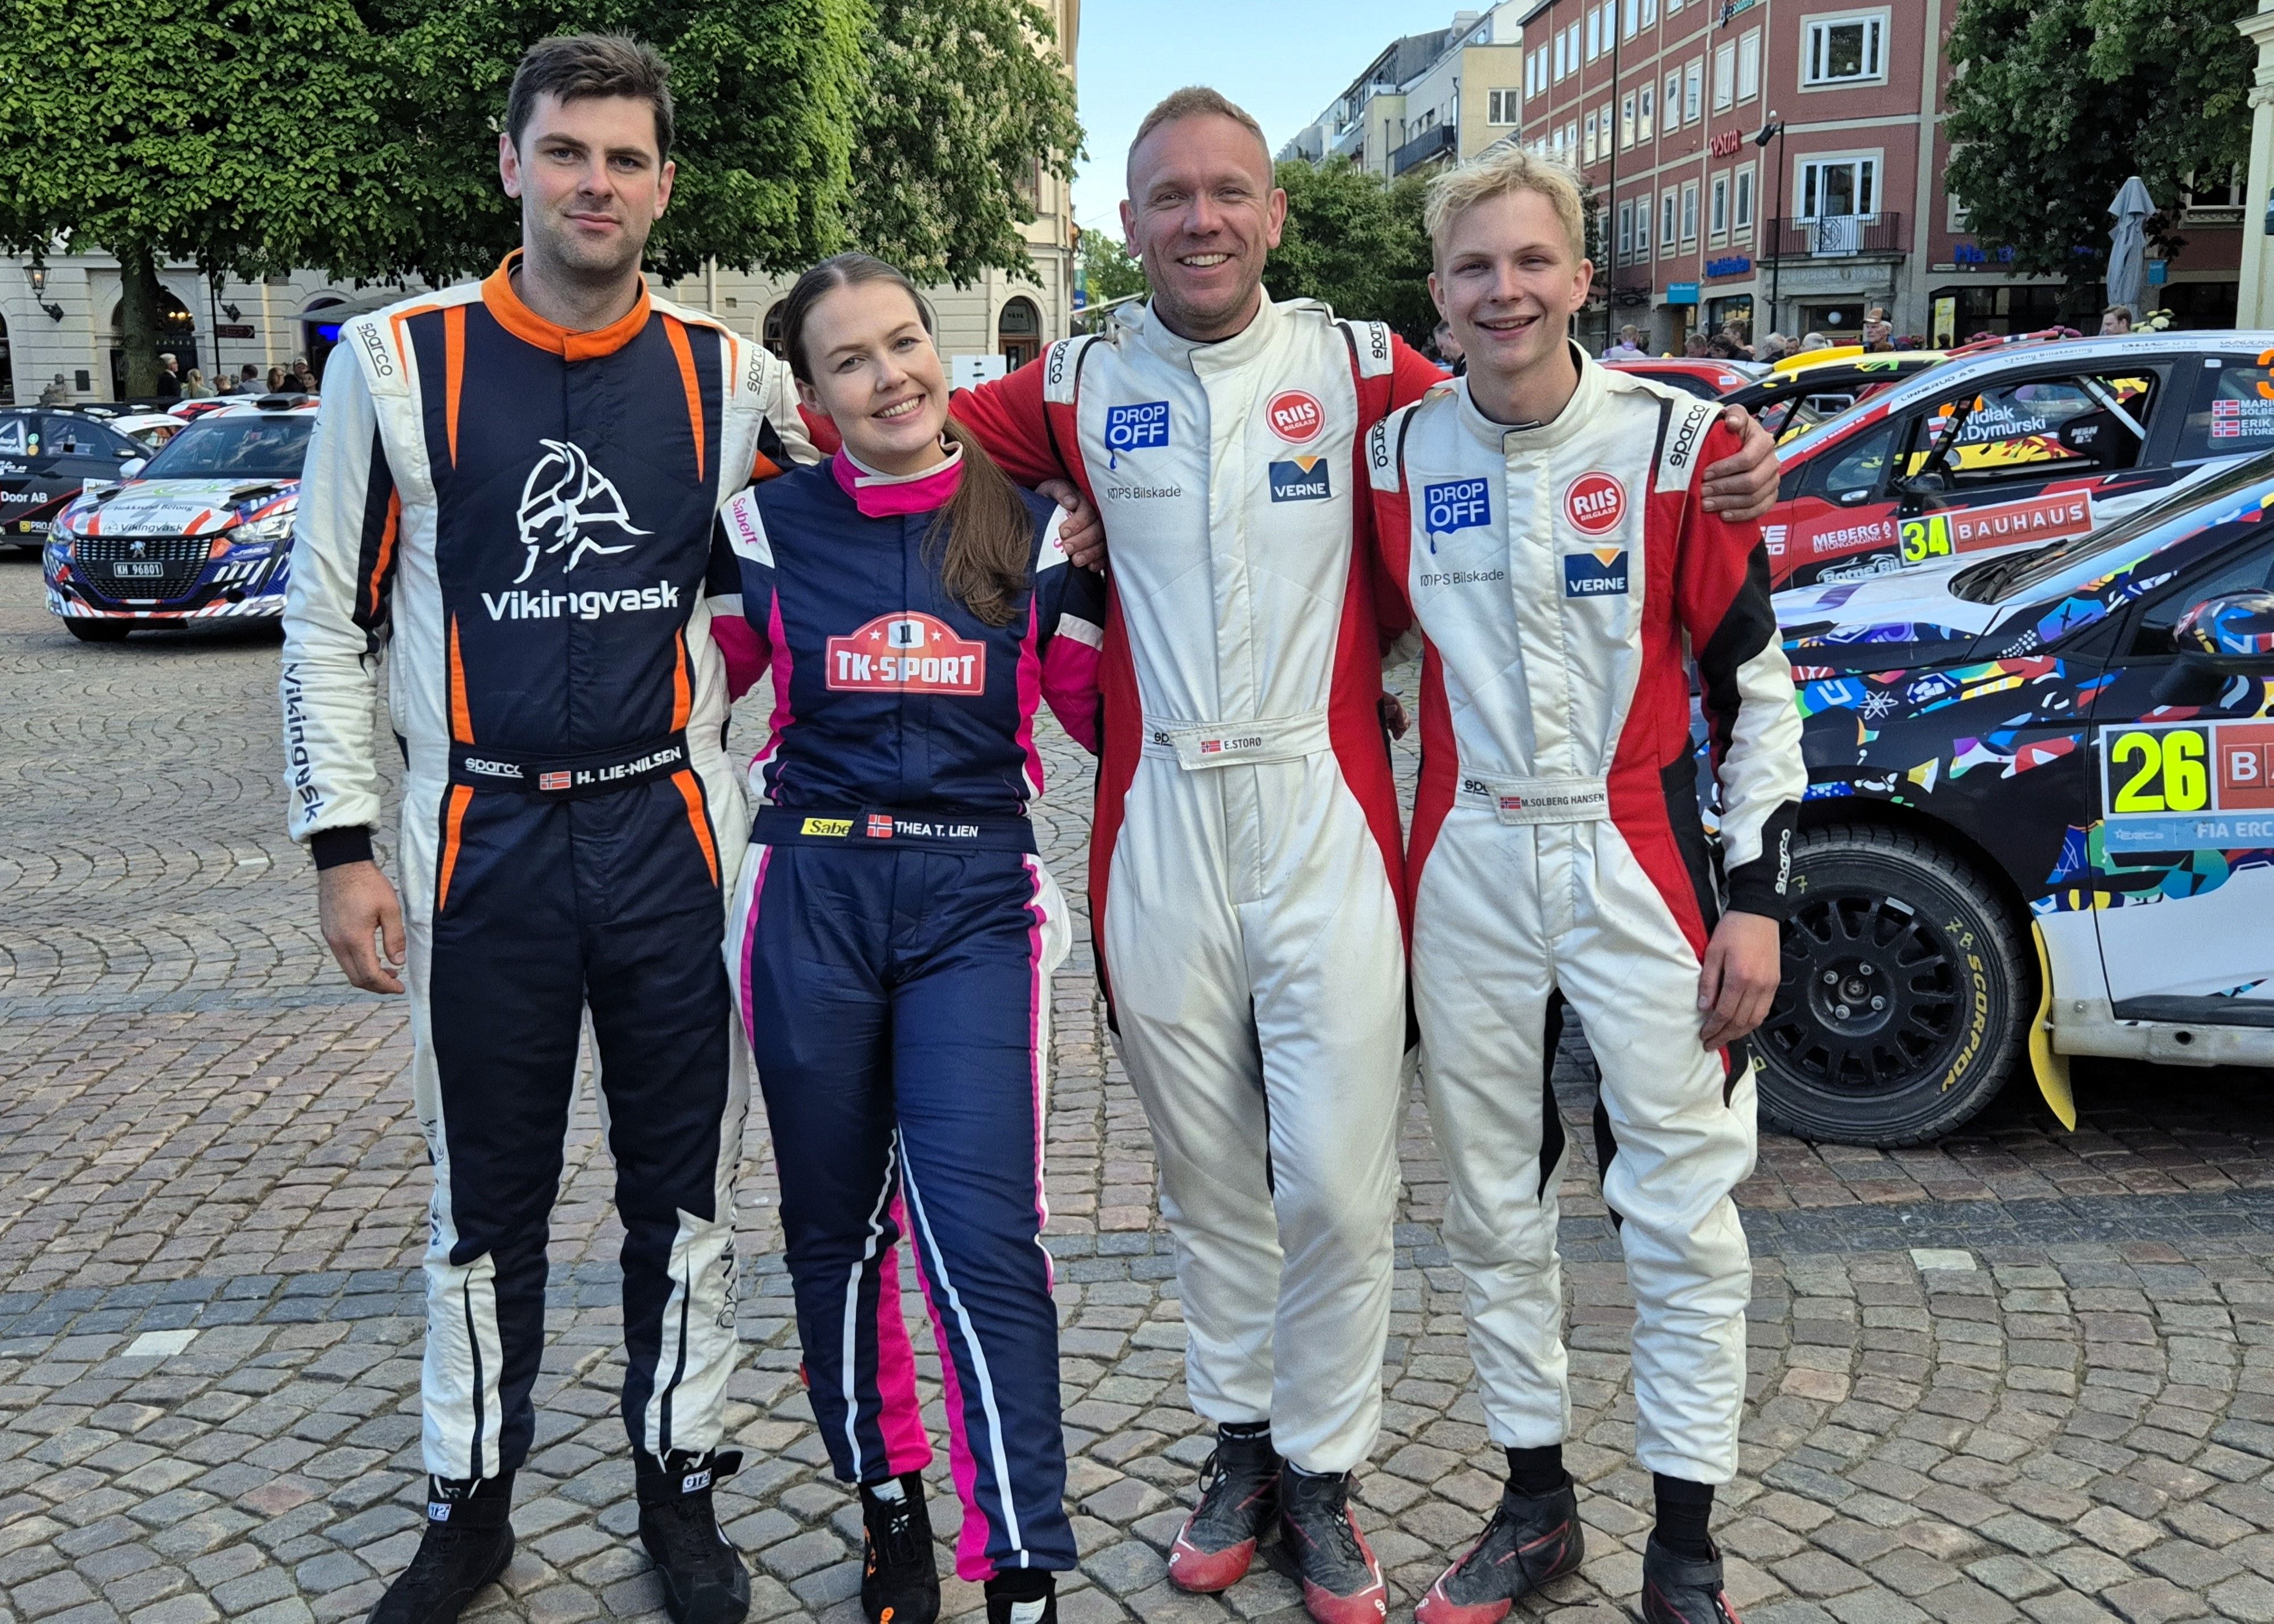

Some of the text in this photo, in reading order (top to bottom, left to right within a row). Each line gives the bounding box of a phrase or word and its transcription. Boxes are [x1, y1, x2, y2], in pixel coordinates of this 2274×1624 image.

[356, 322, 393, 377] sparco
[1049, 339, 1072, 385] parco
[1113, 405, 1165, 424] DROP
[1273, 402, 1316, 427] RIIS
[2240, 400, 2274, 408] MARI
[1110, 422, 1164, 445] OFF
[2241, 418, 2271, 428] ERIK
[1372, 417, 1388, 470] parco
[1670, 404, 1711, 468] sparco
[1, 491, 48, 503] Door AB
[1134, 486, 1181, 499] Bilskade
[1273, 483, 1326, 497] VERNE
[1430, 482, 1484, 504] DROP
[1572, 487, 1618, 516] RIIS
[733, 497, 758, 545] Sabelt
[1430, 500, 1485, 527] OFF
[1812, 523, 1880, 546] MEBERG
[1903, 501, 2085, 561] 34 BAUHAUS
[132, 564, 160, 575] 96801
[1453, 569, 1504, 584] Bilskade
[1569, 576, 1626, 592] VERNE
[481, 580, 679, 621] Vikingvask
[576, 746, 682, 785] H. LIE-NILSEN
[2112, 730, 2207, 812] 26
[1571, 794, 1605, 804] HANSEN
[894, 821, 978, 837] THEA T. LIEN
[2197, 823, 2229, 839] FIA
[1775, 828, 1791, 896] sparco
[1941, 953, 1988, 1093] SCORPION
